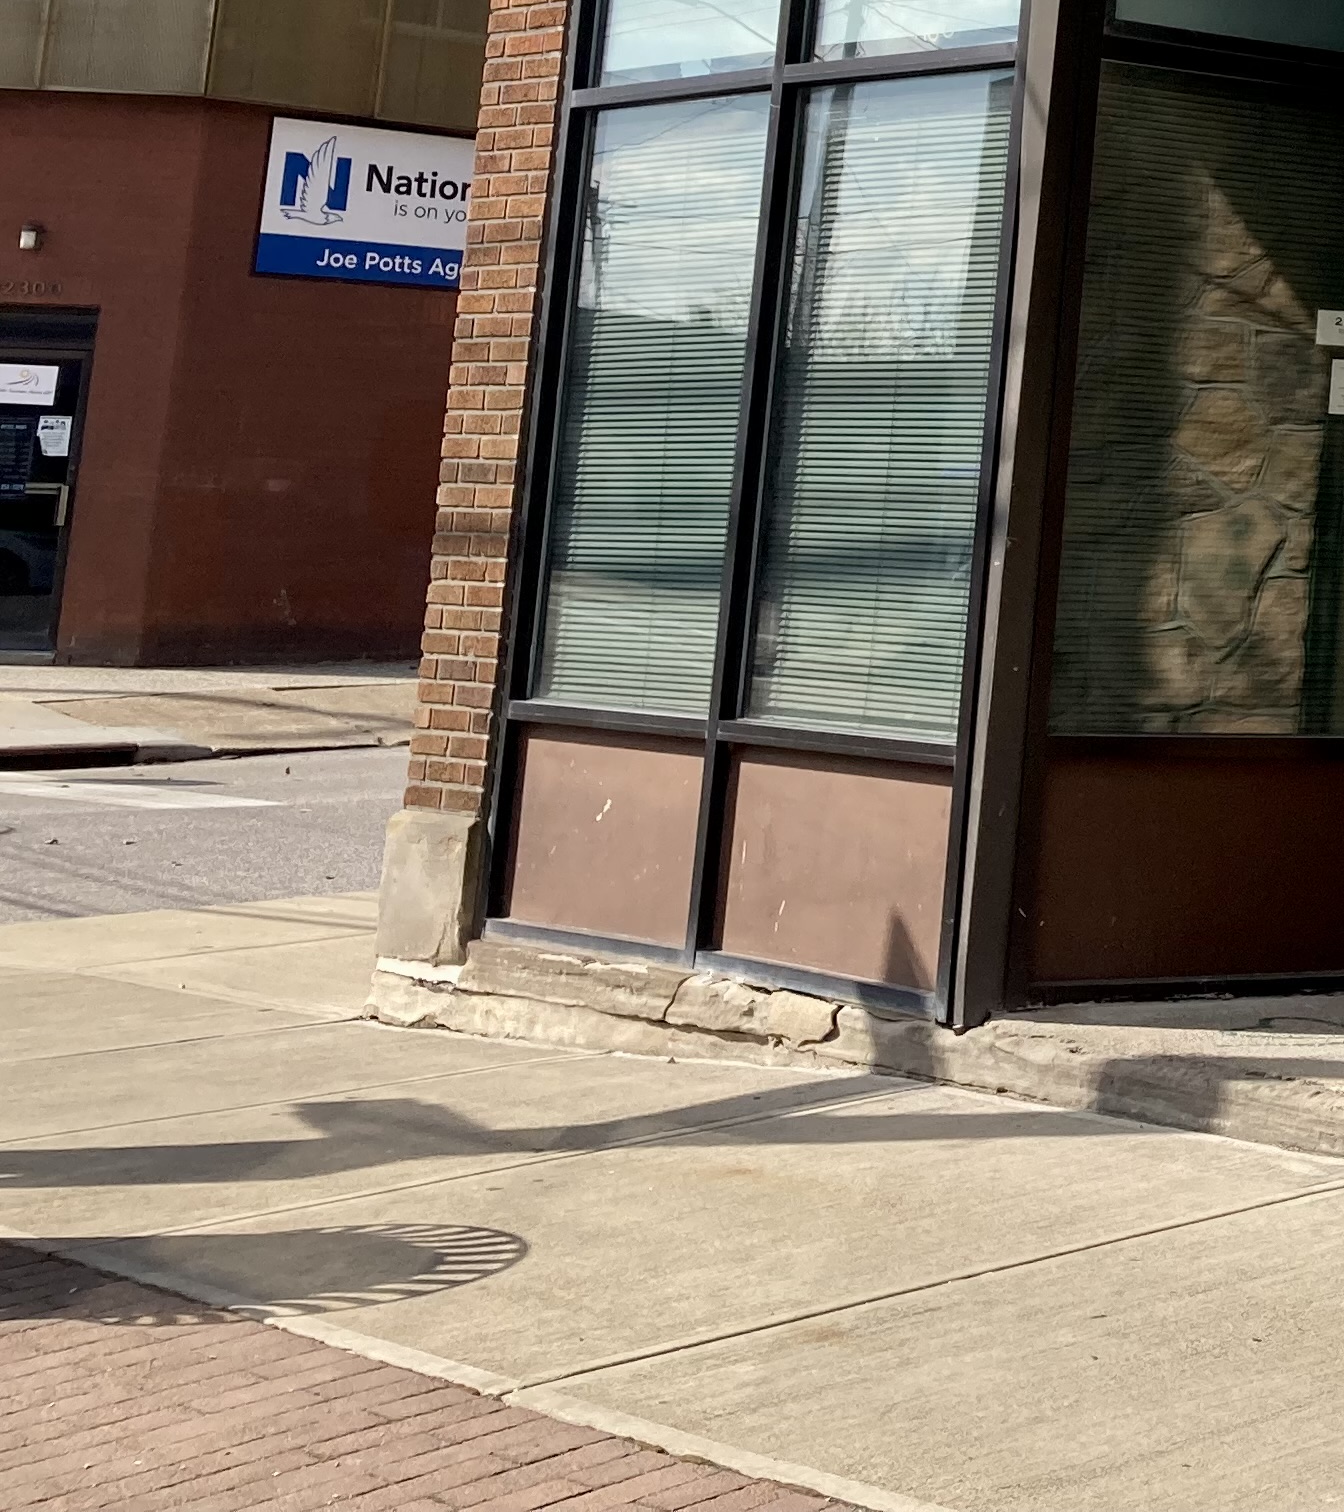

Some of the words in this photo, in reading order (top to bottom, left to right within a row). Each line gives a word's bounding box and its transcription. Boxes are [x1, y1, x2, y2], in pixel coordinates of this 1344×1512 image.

[394, 200, 408, 217] is
[414, 205, 438, 220] on
[443, 208, 467, 224] yo
[316, 248, 358, 269] Joe
[364, 251, 422, 274] Potts
